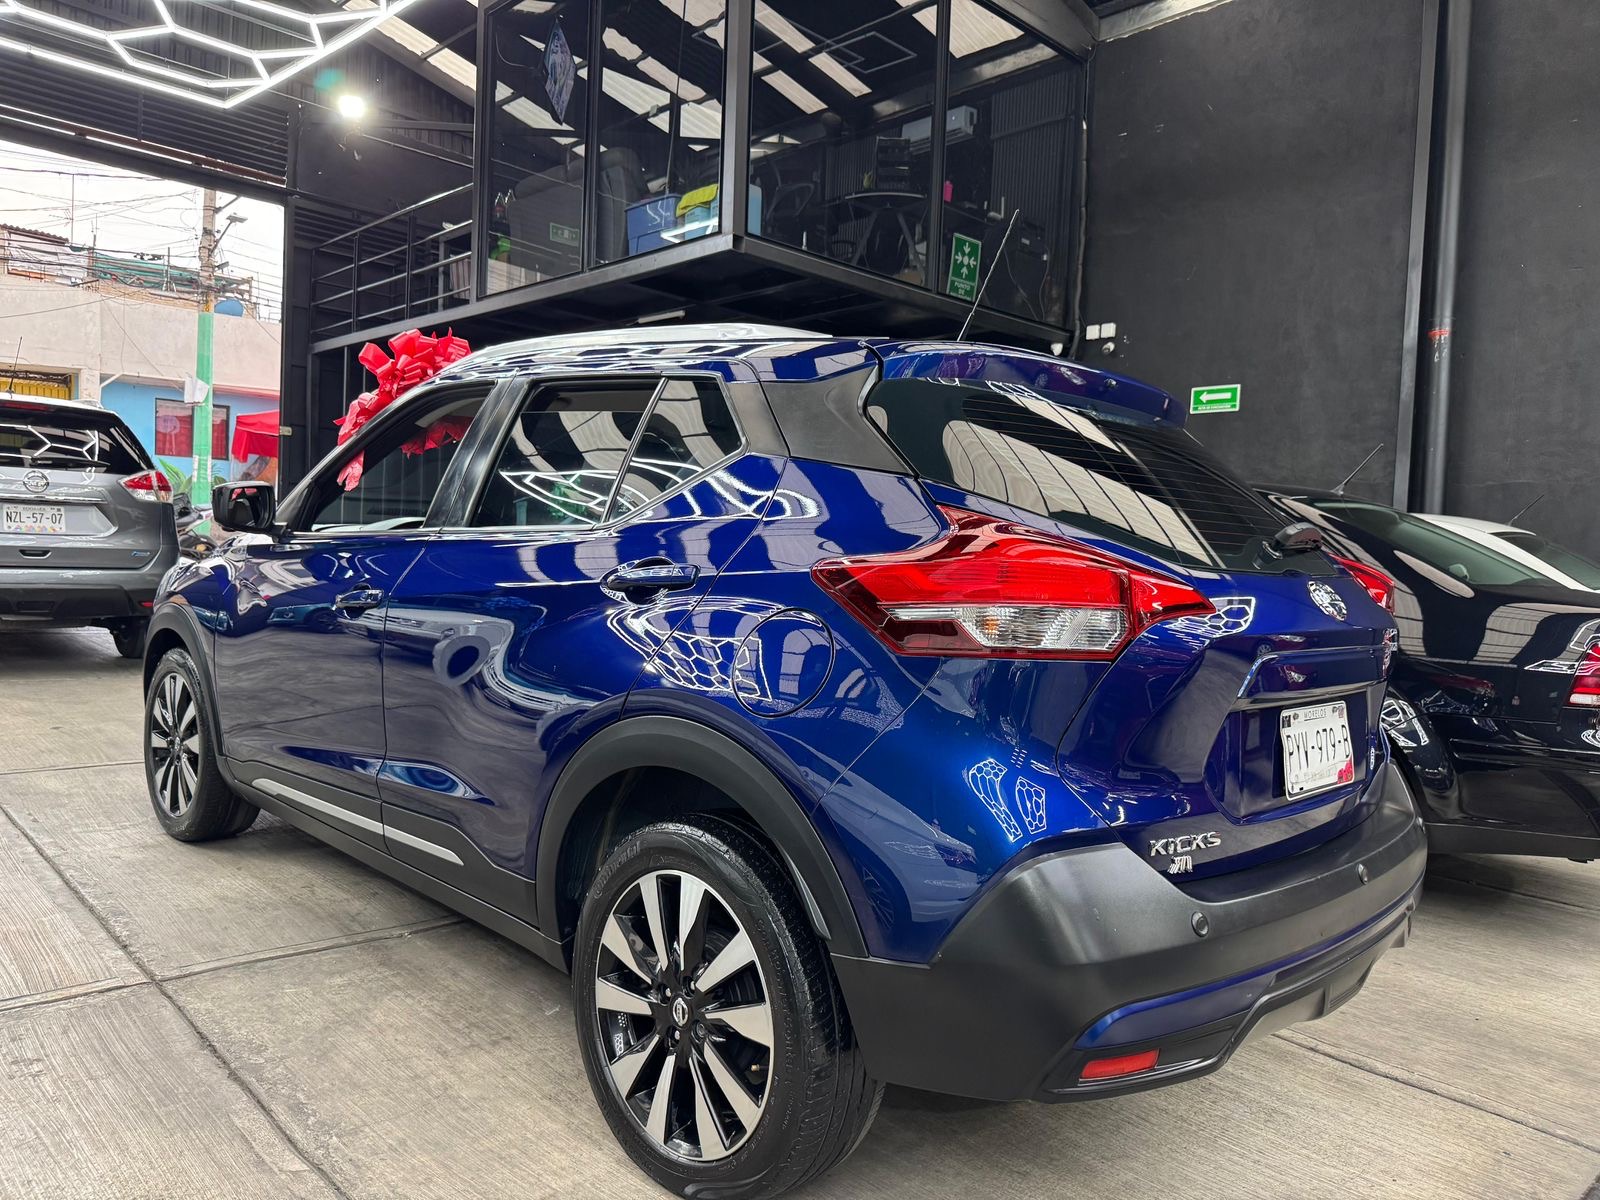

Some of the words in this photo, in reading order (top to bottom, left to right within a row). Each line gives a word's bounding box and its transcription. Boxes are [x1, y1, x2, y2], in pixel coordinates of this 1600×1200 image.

[6, 511, 63, 525] NZL-57-07
[1286, 724, 1350, 774] PYV-979-B
[1149, 831, 1221, 857] KICKS
